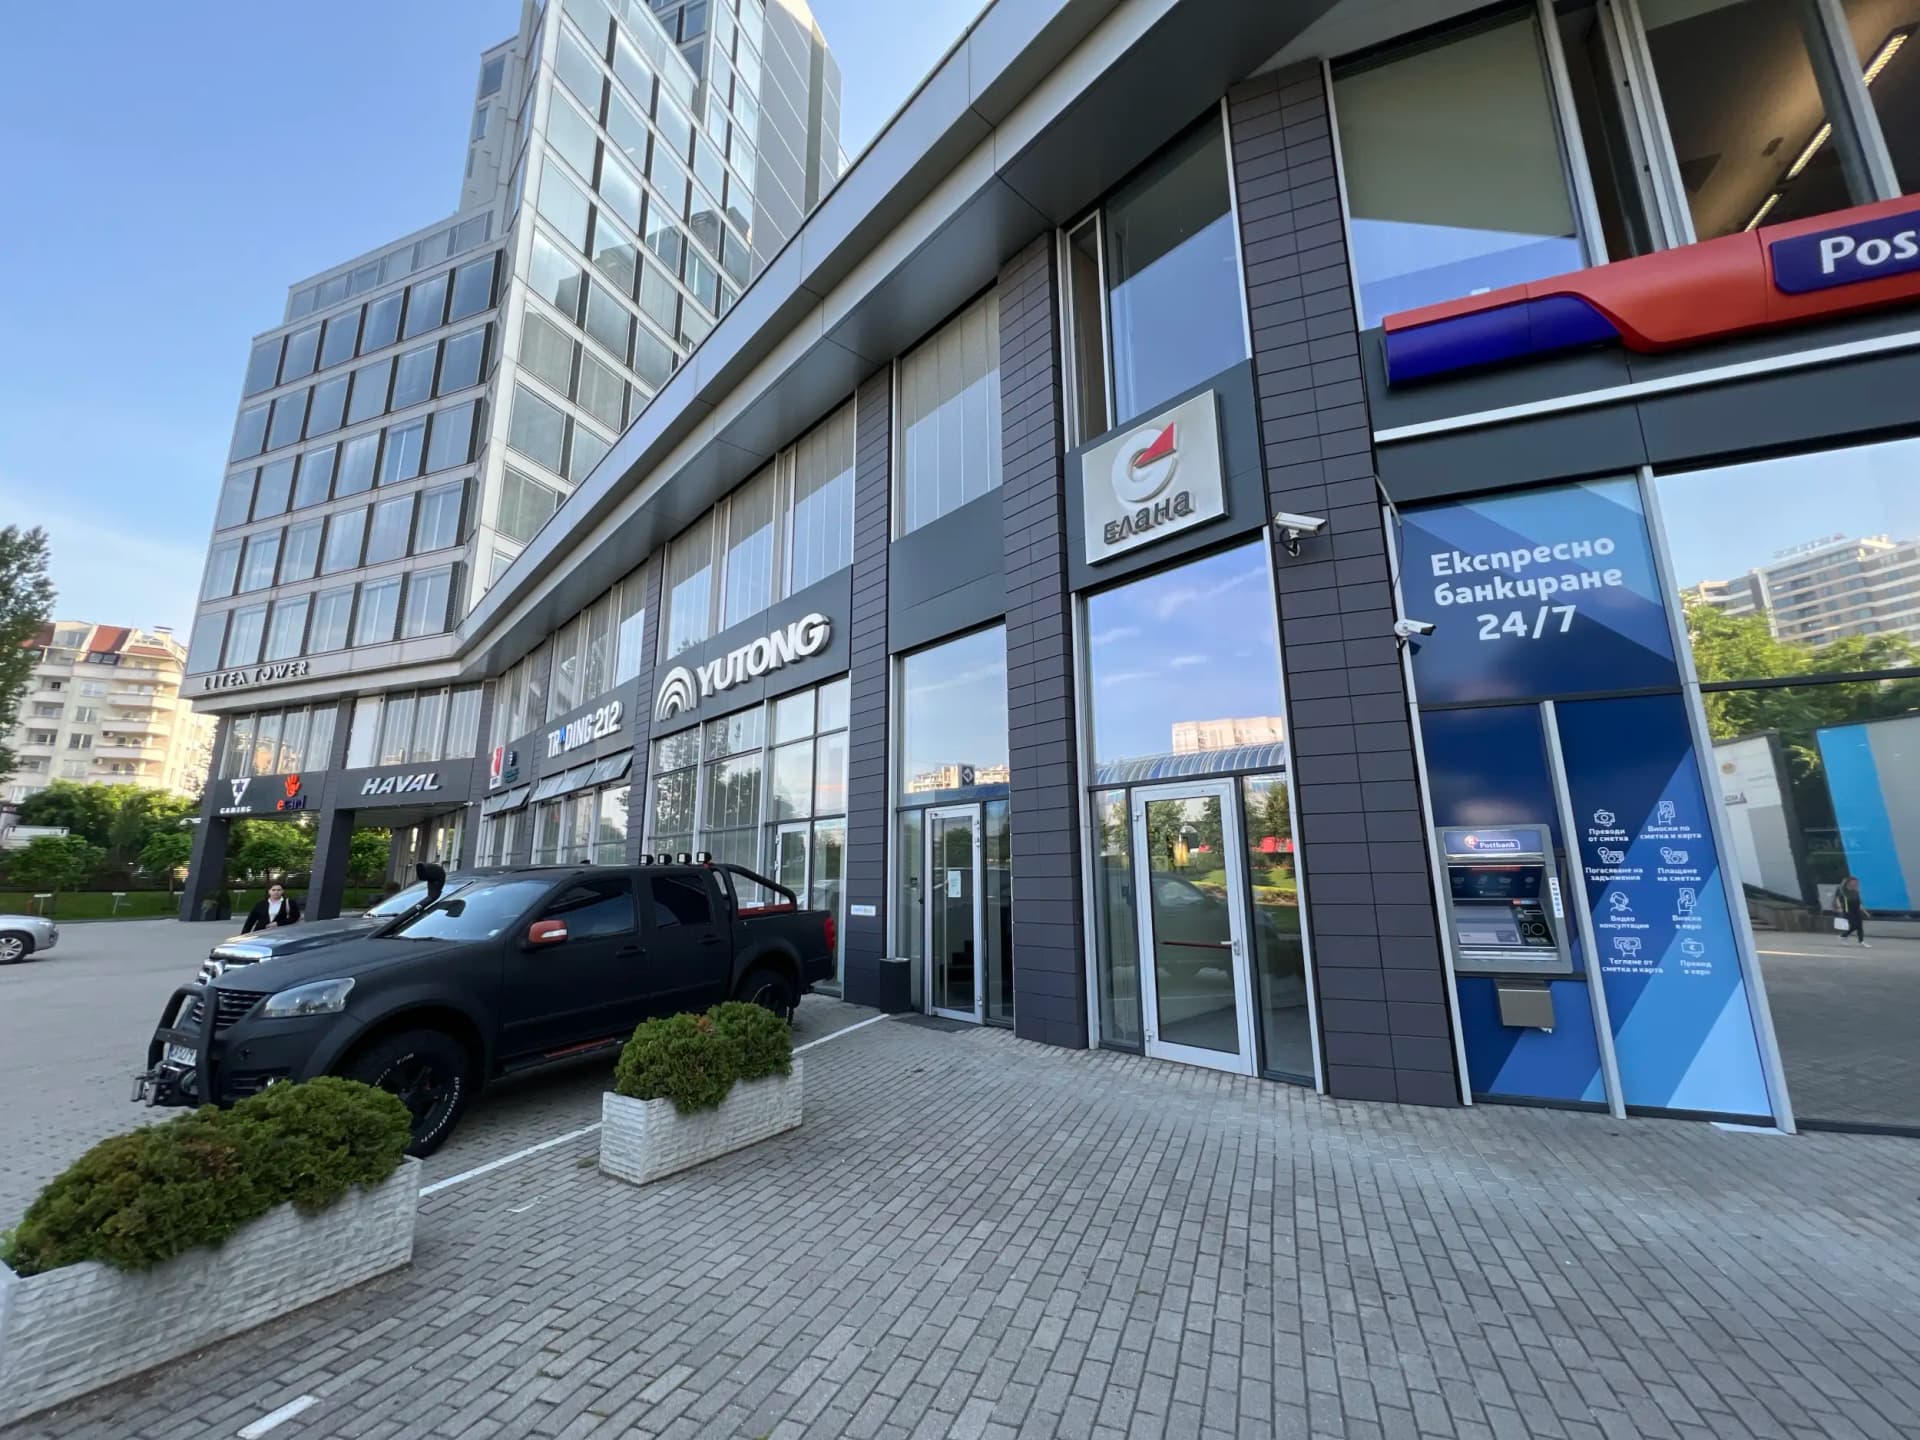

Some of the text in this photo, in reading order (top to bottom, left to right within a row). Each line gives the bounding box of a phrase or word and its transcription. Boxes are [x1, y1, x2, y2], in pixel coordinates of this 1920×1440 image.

[1431, 537, 1615, 577] Експресно
[1434, 568, 1623, 606] банкиране
[1477, 604, 1577, 641] 24/7
[254, 660, 308, 683] TOWER
[696, 612, 831, 697] YUTONG
[360, 772, 441, 796] HAVAL
